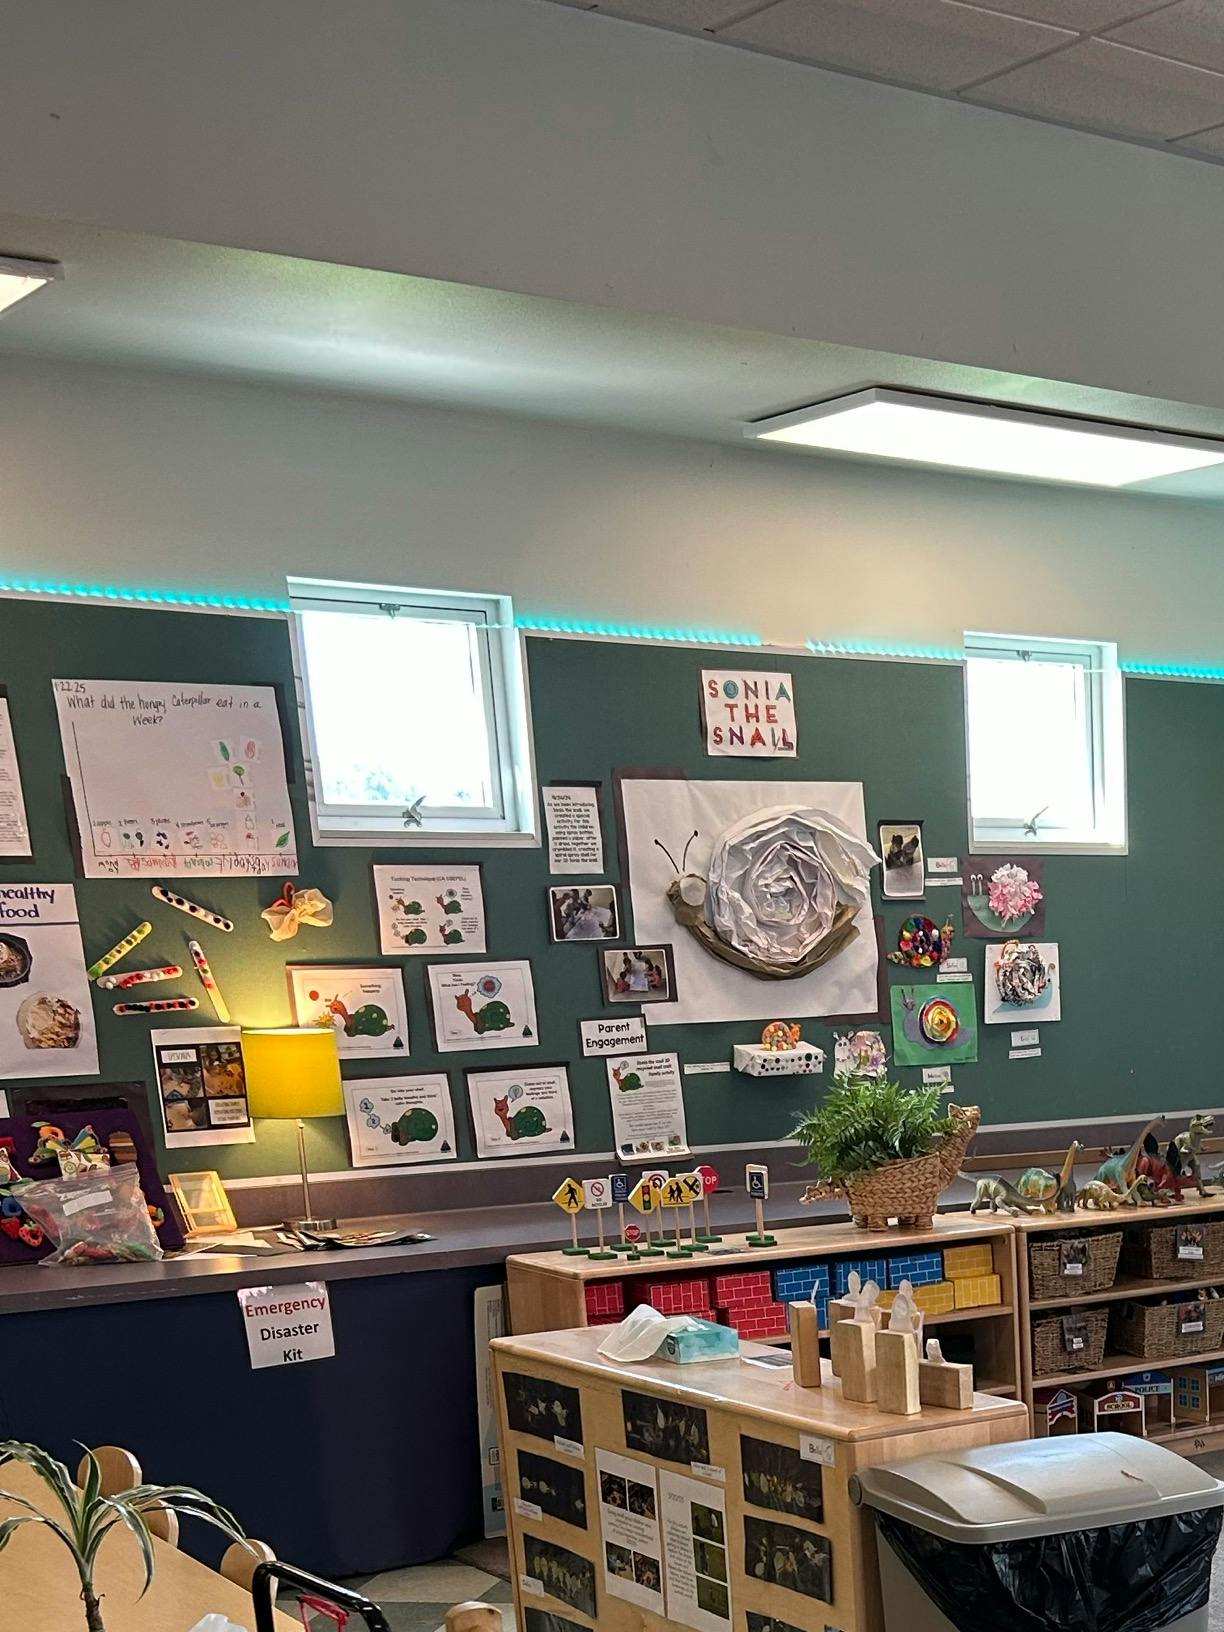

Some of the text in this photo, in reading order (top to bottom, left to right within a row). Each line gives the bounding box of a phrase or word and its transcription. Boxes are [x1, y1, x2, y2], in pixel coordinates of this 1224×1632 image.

[708, 679, 791, 703] SONIA
[67, 695, 94, 709] What
[100, 694, 115, 709] did
[119, 695, 135, 710] the
[216, 696, 233, 709] eat
[239, 697, 249, 709] in
[253, 701, 263, 709] a
[725, 703, 778, 723] THE
[713, 725, 794, 752] SNAIL
[598, 1021, 630, 1034] Parent
[586, 1035, 644, 1049] Engagement
[363, 1102, 370, 1110] 1
[701, 1174, 718, 1186] TOP
[626, 1229, 639, 1237] STOP
[245, 1297, 326, 1318] Emergency
[259, 1321, 320, 1342] Disaster
[282, 1347, 304, 1363] Kit
[1134, 1385, 1160, 1394] POLICE
